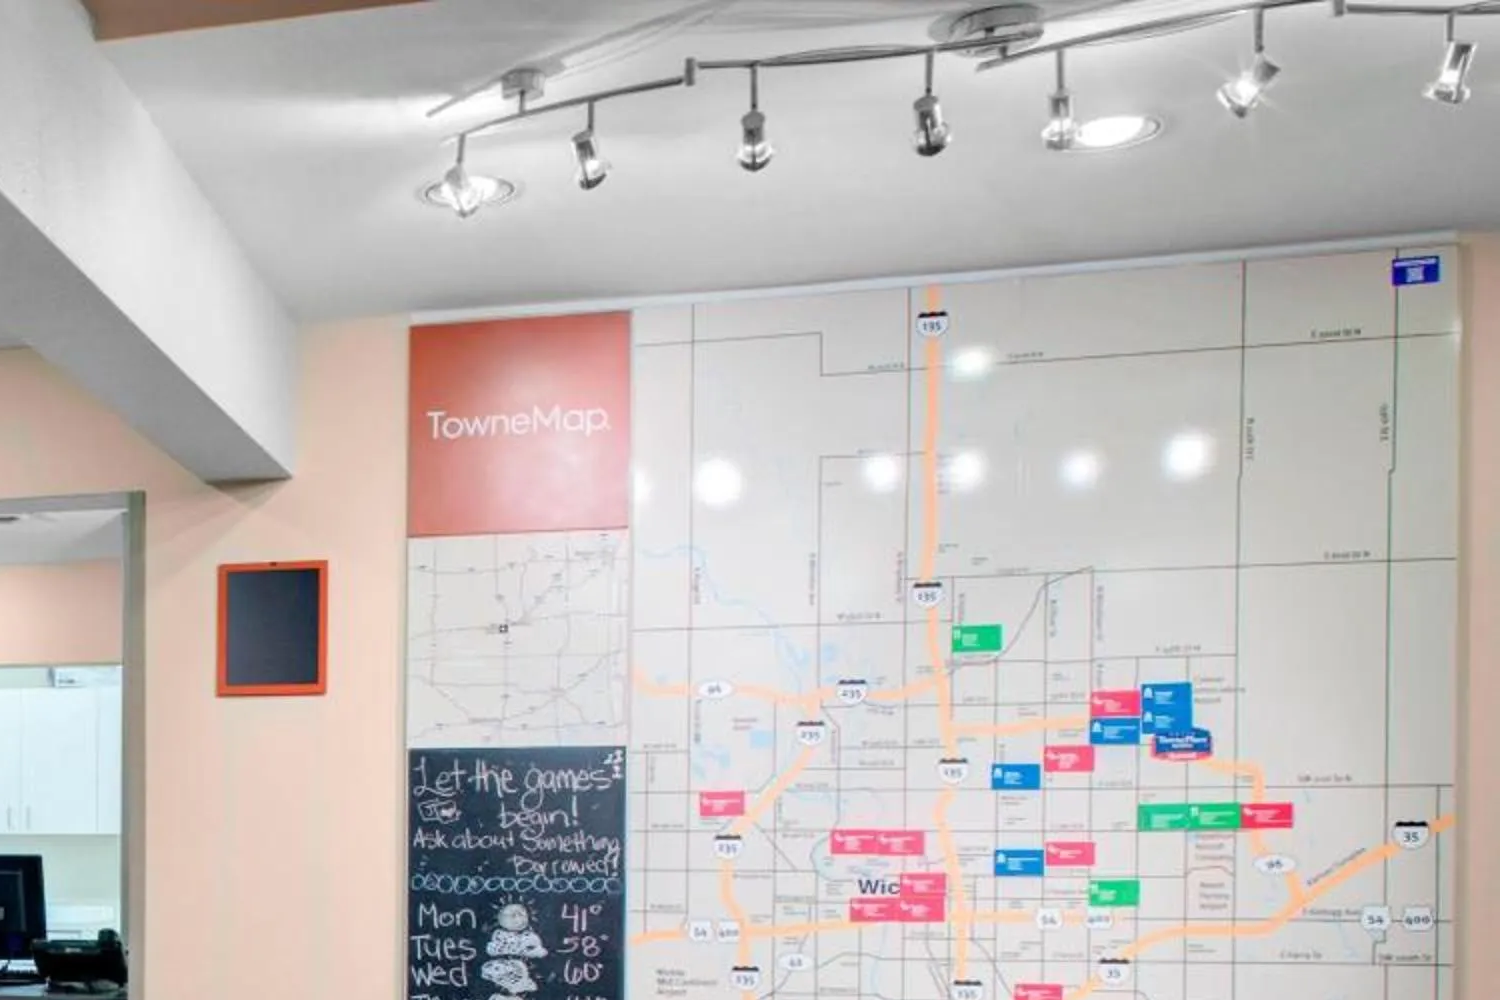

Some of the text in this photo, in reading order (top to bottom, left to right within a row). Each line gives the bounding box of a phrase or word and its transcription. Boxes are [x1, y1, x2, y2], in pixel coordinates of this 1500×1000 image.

[414, 756, 613, 812] Let the games
[498, 795, 580, 839] begin!
[414, 827, 448, 850] Ask
[451, 826, 515, 850] about
[1404, 831, 1420, 843] 35
[418, 902, 477, 930] Mon
[411, 934, 478, 961] Tues
[411, 961, 469, 987] Wed
